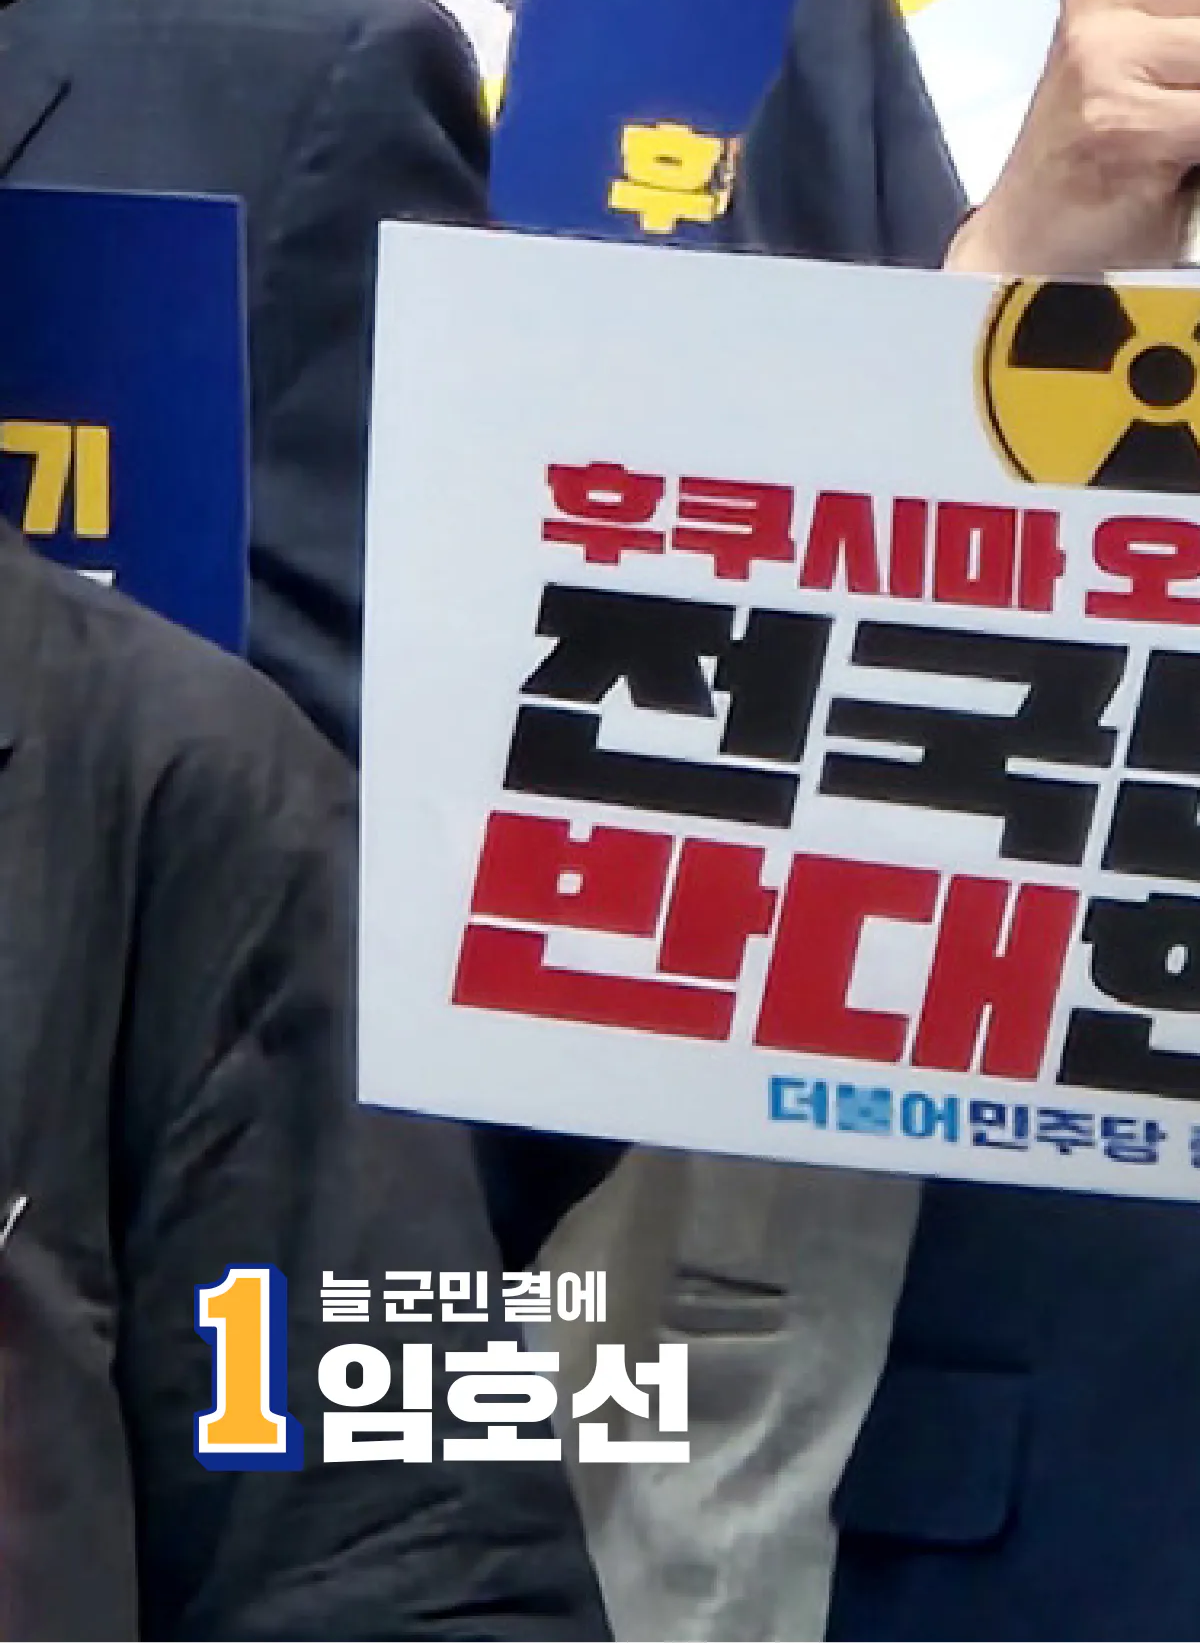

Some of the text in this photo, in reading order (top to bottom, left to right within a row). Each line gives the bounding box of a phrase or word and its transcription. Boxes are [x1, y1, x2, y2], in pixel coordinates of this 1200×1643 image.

[608, 121, 740, 234] 후
[541, 460, 1067, 614] 후쿠시마
[767, 1072, 1168, 1166] 더불어민주당
